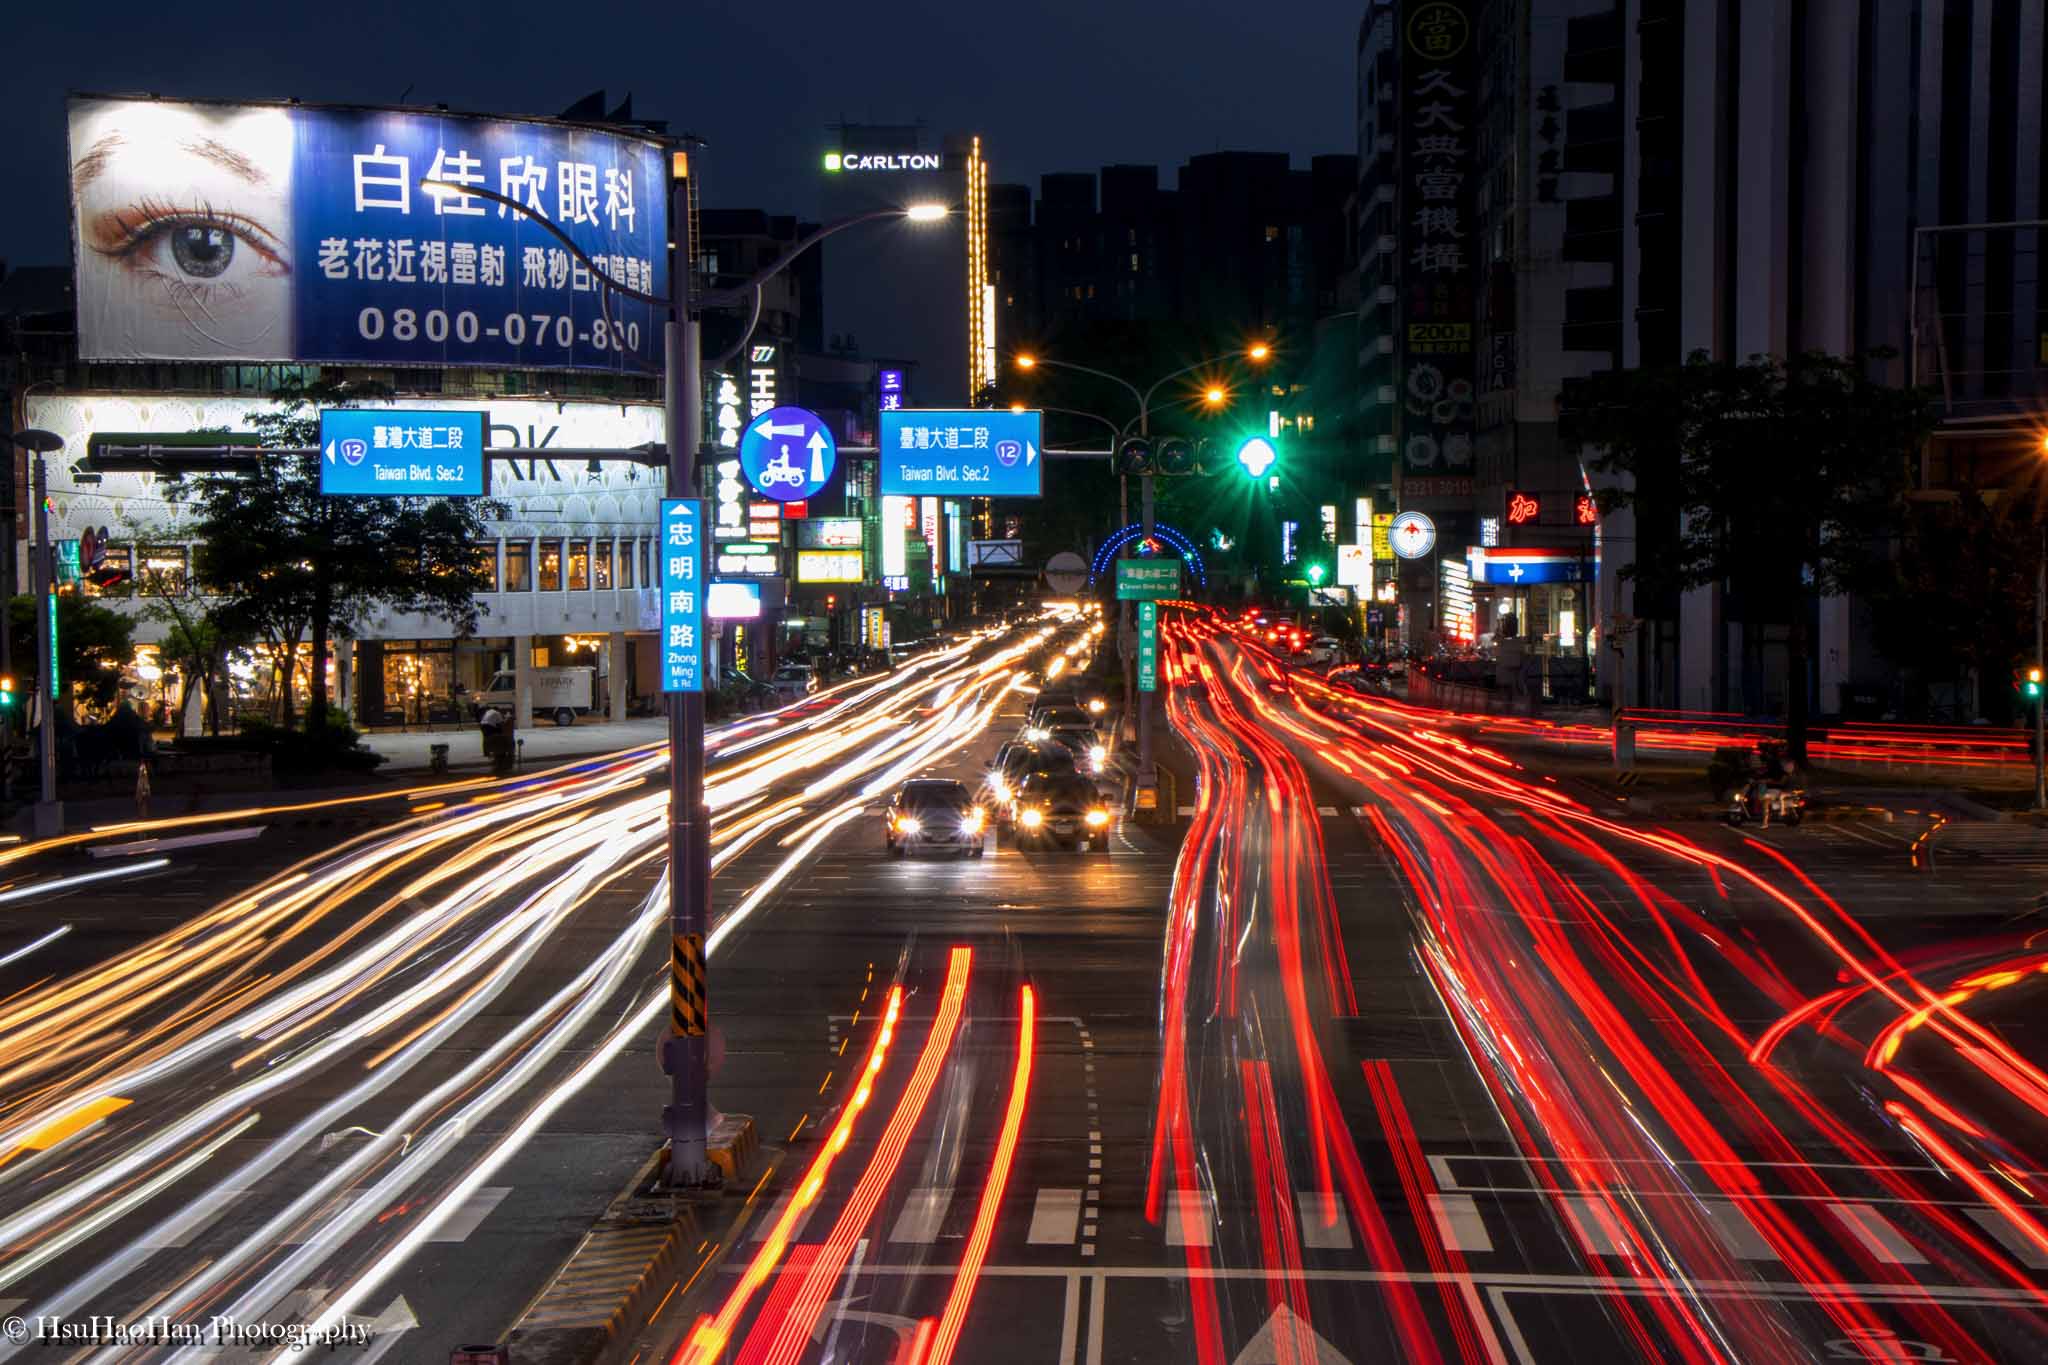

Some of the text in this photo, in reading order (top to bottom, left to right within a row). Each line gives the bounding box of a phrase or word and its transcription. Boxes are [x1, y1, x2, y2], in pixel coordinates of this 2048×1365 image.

[843, 154, 940, 170] CARLTON
[352, 144, 637, 233] 白佳欣眼科
[318, 237, 506, 287] 老花近視雷射
[372, 426, 464, 450] 臺灣大道二段
[900, 426, 990, 450] 臺灣大道二段
[344, 445, 363, 459] 12
[1000, 446, 1017, 458] 12
[372, 463, 406, 482] Taiwan
[409, 463, 434, 482] Blvd.
[900, 465, 932, 481] Taiwan
[936, 465, 960, 481] Blvd.
[669, 521, 694, 648] 忠明南路
[668, 652, 697, 666] Zhong
[671, 666, 694, 679] Ming
